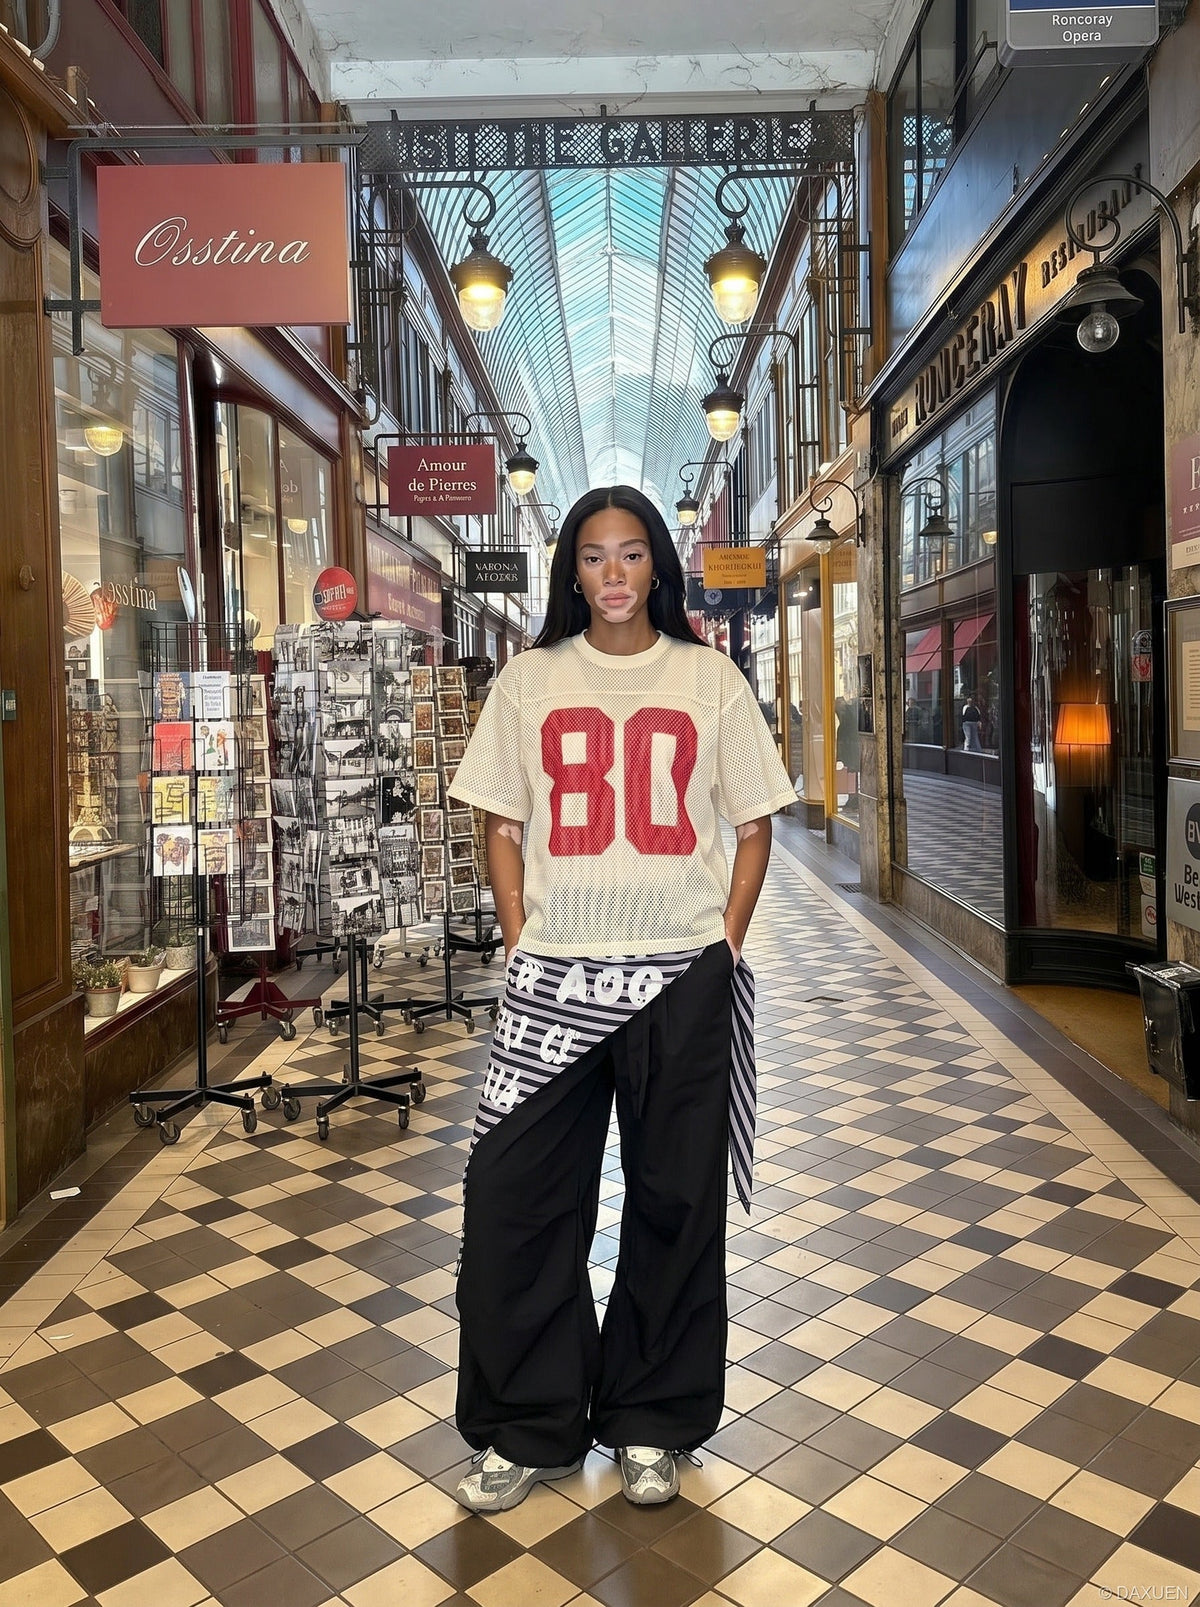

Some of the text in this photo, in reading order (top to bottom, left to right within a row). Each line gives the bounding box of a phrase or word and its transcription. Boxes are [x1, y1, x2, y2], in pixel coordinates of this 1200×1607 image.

[1052, 14, 1113, 27] Roncoray
[1062, 30, 1102, 44] Opera
[135, 216, 311, 267] Osstina
[417, 458, 467, 472] Amour
[408, 478, 477, 492] de Pierres
[541, 706, 698, 857] 80
